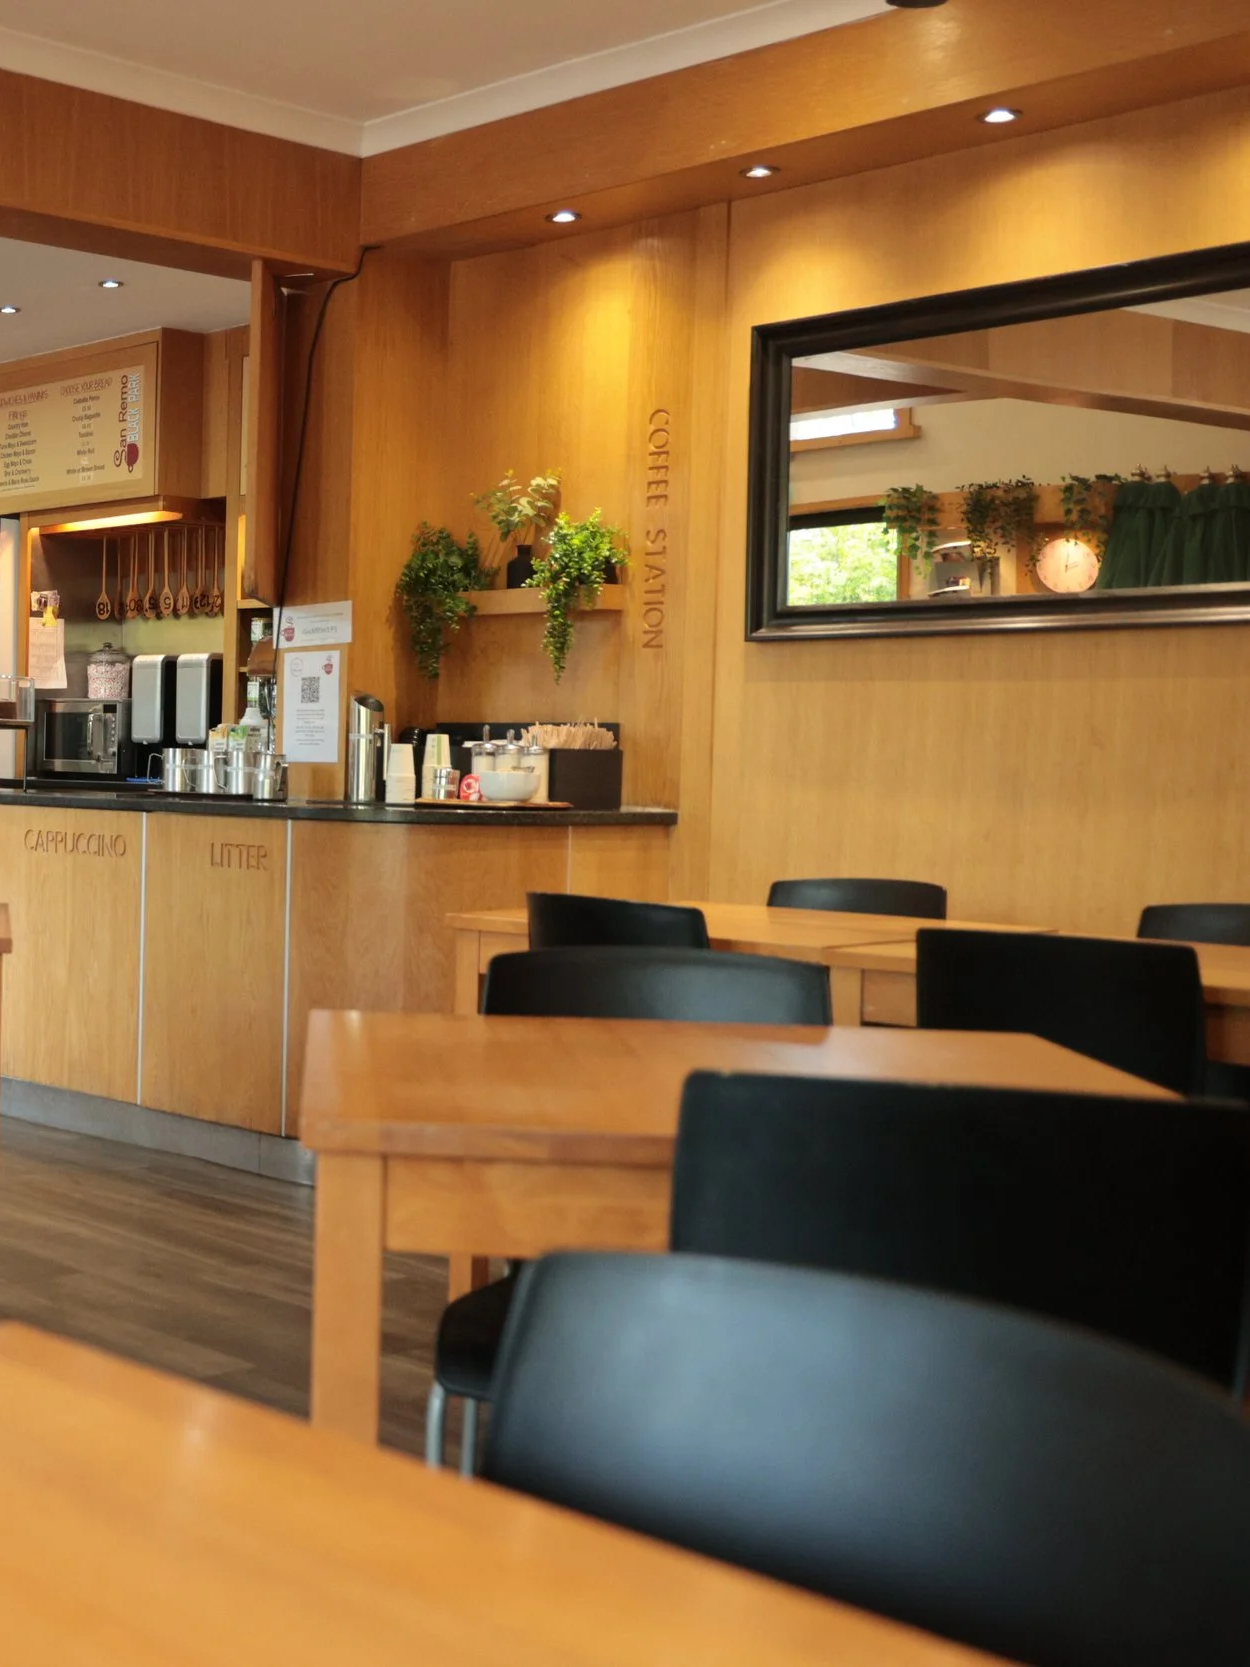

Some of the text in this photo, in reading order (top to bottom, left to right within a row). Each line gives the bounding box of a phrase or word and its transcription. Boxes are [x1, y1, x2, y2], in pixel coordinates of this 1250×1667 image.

[114, 375, 128, 467] San Remo
[128, 374, 141, 442] BLACK PARK
[642, 408, 670, 649] COFFEE STATION
[97, 602, 110, 616] 18
[24, 829, 126, 857] CAPPUCCINO
[210, 842, 267, 870] LITTER
